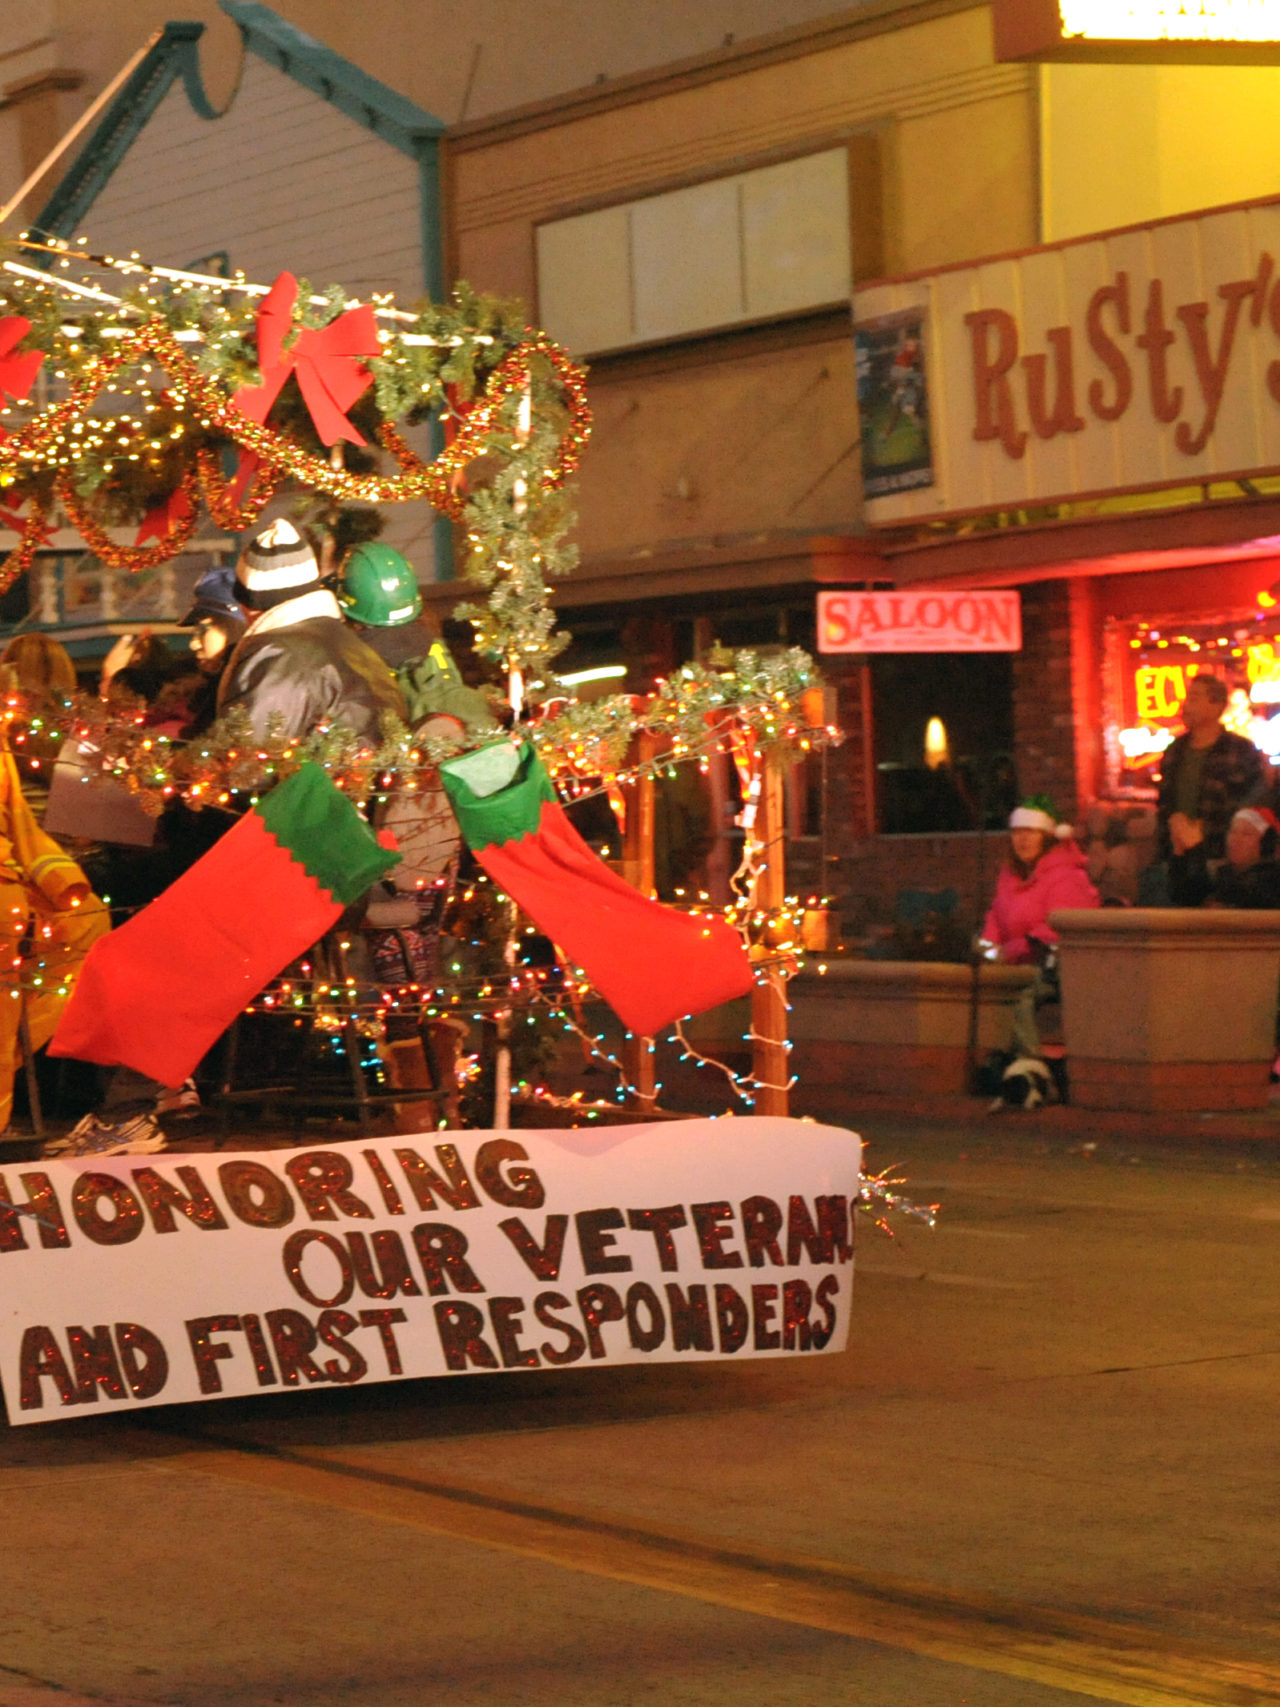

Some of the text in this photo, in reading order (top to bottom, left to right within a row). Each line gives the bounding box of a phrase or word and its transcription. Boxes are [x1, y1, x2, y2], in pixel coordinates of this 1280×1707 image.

[824, 597, 1014, 647] SALOON
[282, 1222, 487, 1308] OUR
[20, 1273, 840, 1410] AND FIRST RESPONDERS
